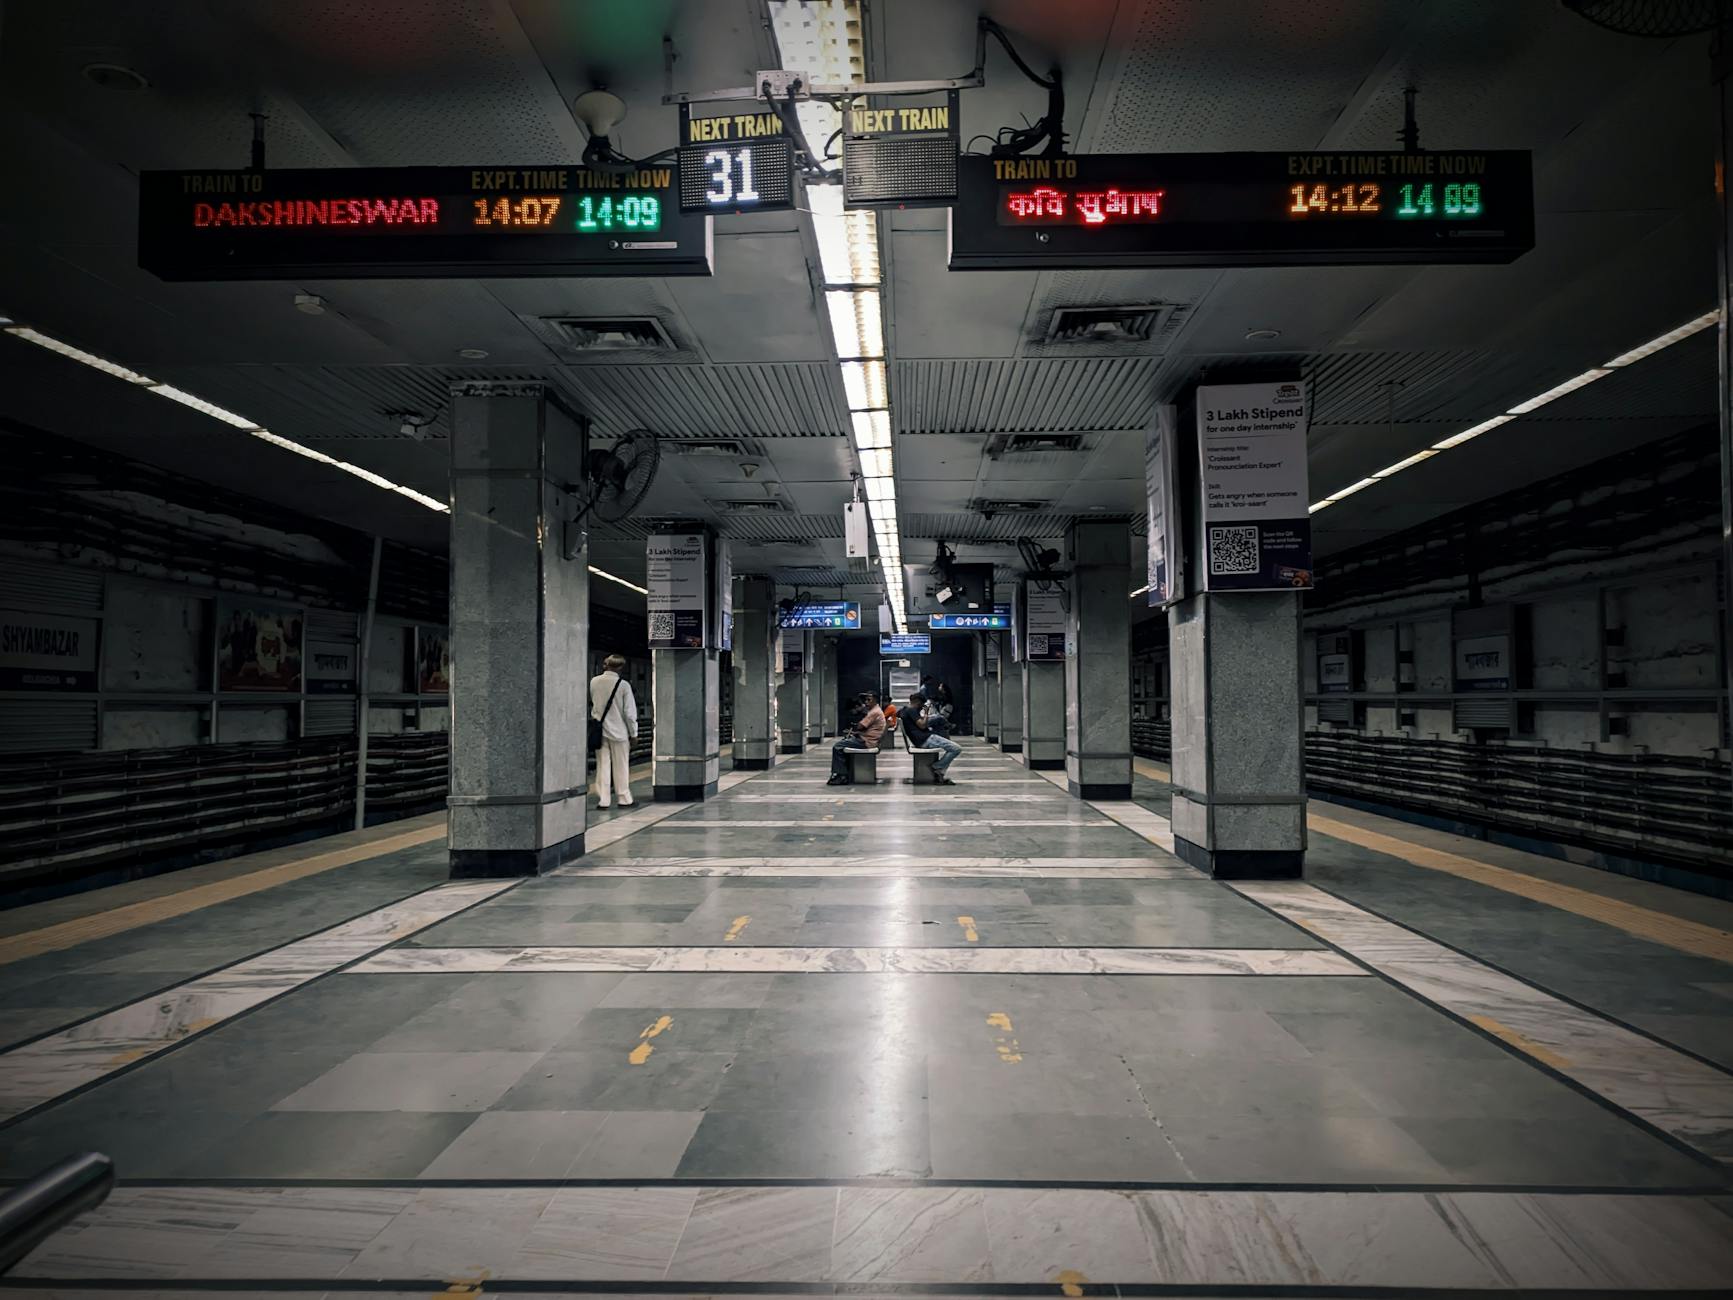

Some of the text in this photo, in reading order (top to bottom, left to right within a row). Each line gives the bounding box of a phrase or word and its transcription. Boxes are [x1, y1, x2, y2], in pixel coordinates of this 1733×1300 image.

[690, 111, 783, 142] NEXT TRAIN
[852, 107, 949, 133] NEXT TRAIN
[704, 149, 759, 204] 31
[993, 158, 1077, 180] TRAIN TO
[1390, 155, 1487, 175] TIME NOW
[181, 174, 264, 193] TRAIN TO
[576, 168, 672, 189] TIME NOW
[1008, 189, 1163, 223] कवि सुभाष
[1290, 184, 1380, 213] 14:12
[193, 198, 440, 227] DAKSHINESWAR
[474, 196, 561, 226] 14:07
[578, 196, 660, 228] 14:09
[1206, 406, 1303, 421] 3 Lakh Stipend
[1237, 424, 1252, 433] day
[1209, 501, 1224, 509] calls
[1226, 492, 1246, 501] angry
[673, 548, 701, 556] Stipend
[3, 624, 79, 656] SHYAMBAZAR
